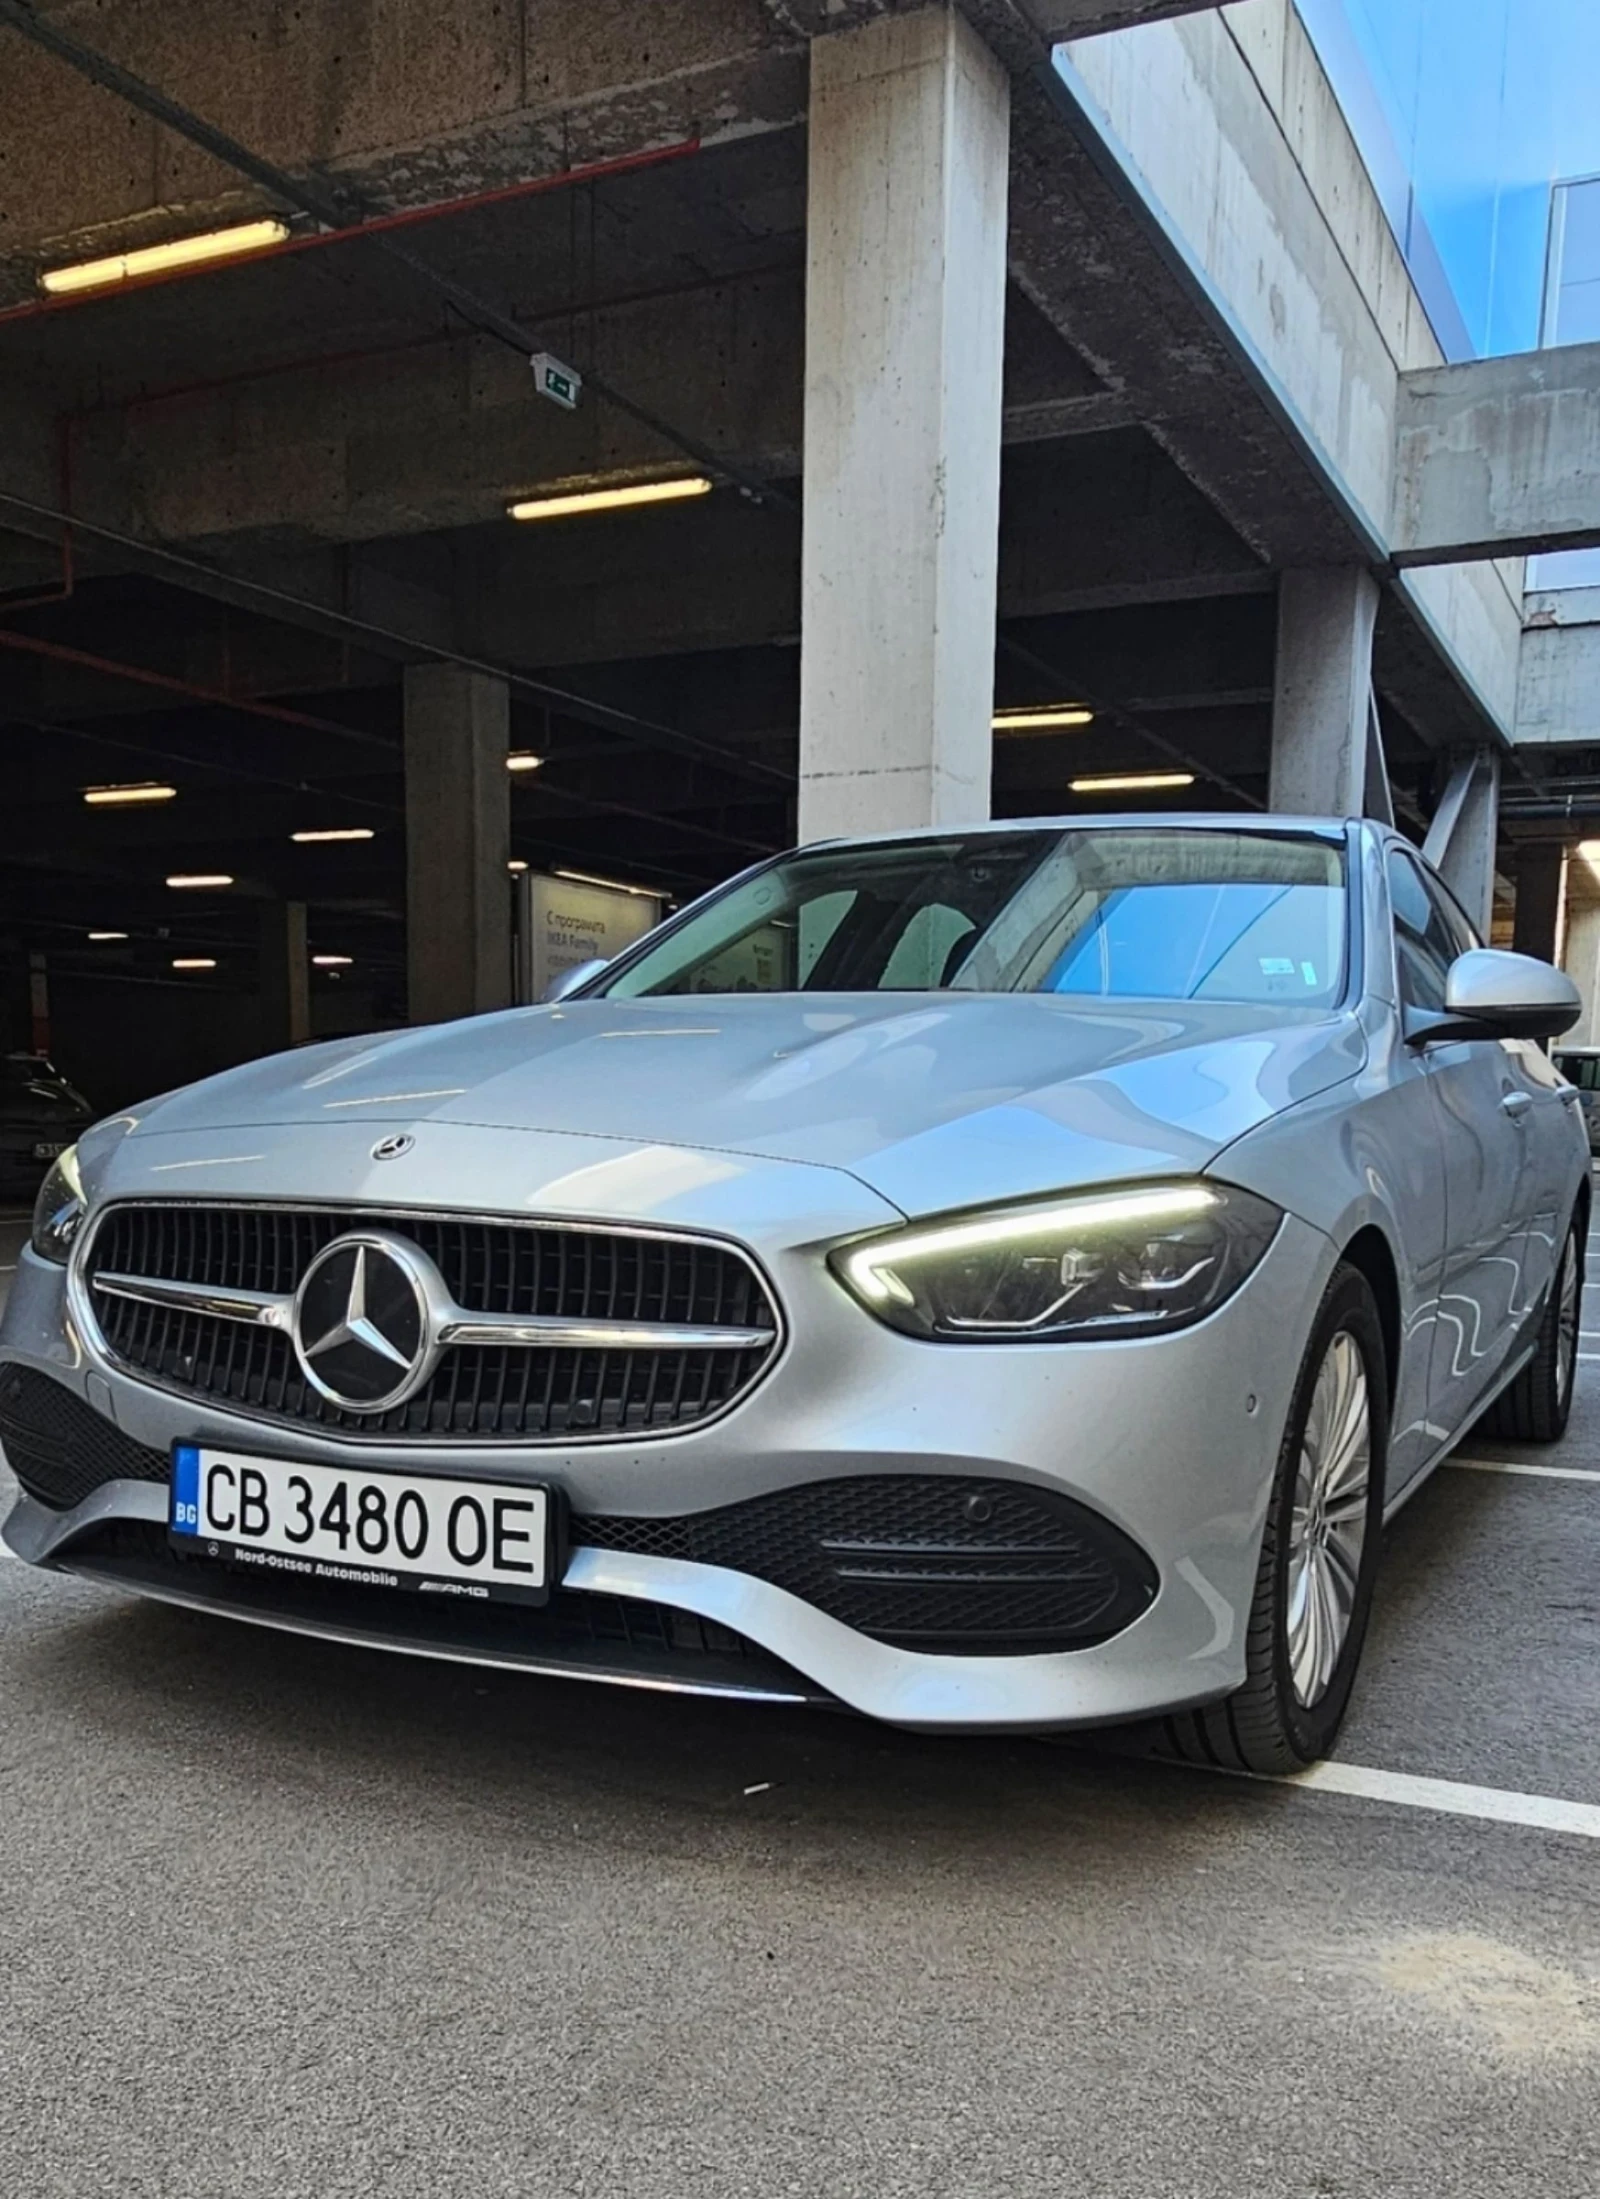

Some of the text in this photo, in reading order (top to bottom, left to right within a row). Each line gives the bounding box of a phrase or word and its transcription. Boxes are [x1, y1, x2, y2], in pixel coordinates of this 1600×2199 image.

[176, 1501, 196, 1524] BG
[207, 1464, 534, 1574] CB 3480 OE
[235, 1548, 398, 1586] Nord-Ostsee Automobile
[439, 1583, 489, 1598] AMG
